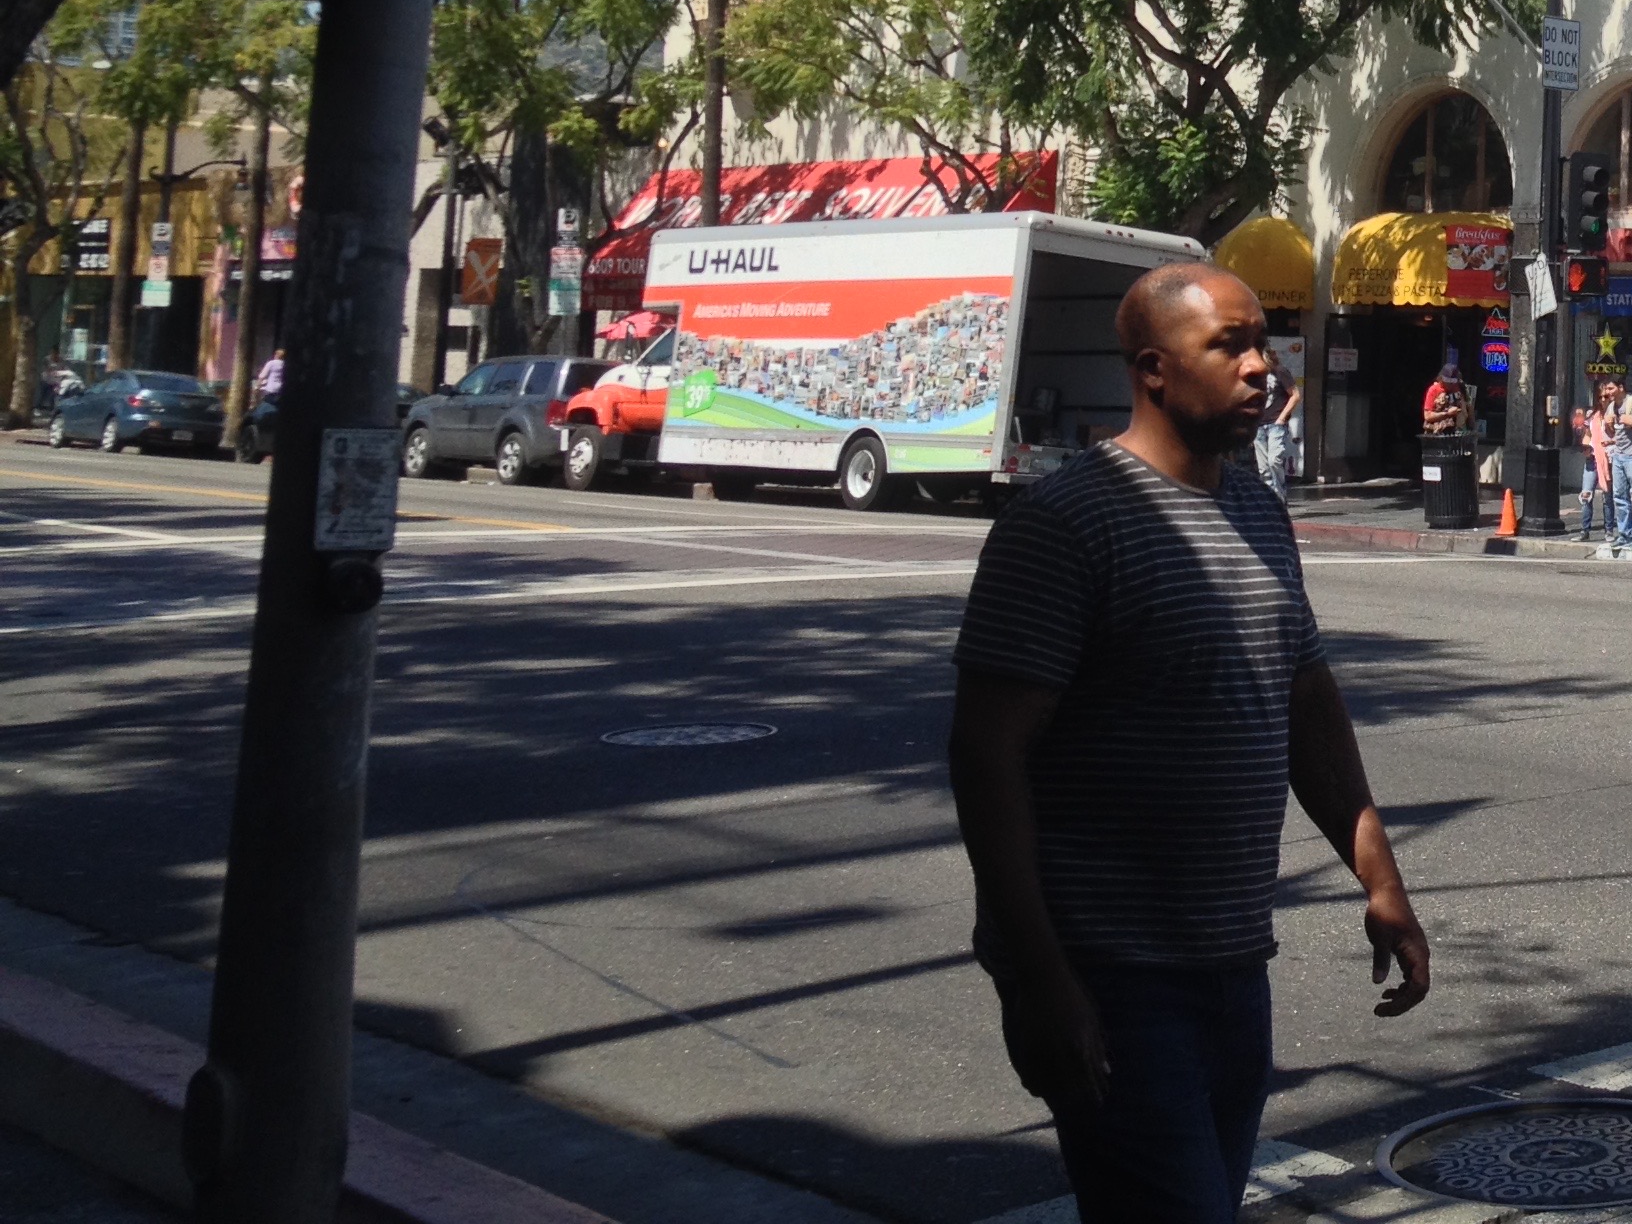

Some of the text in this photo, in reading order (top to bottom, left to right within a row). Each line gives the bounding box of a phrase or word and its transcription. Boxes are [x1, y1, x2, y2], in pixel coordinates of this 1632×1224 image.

[1545, 26, 1578, 45] DO NOT
[1544, 49, 1578, 68] BLOCK
[688, 247, 779, 274] U-HAUL
[1258, 289, 1307, 303] DINNER
[1403, 284, 1442, 297] PASTA
